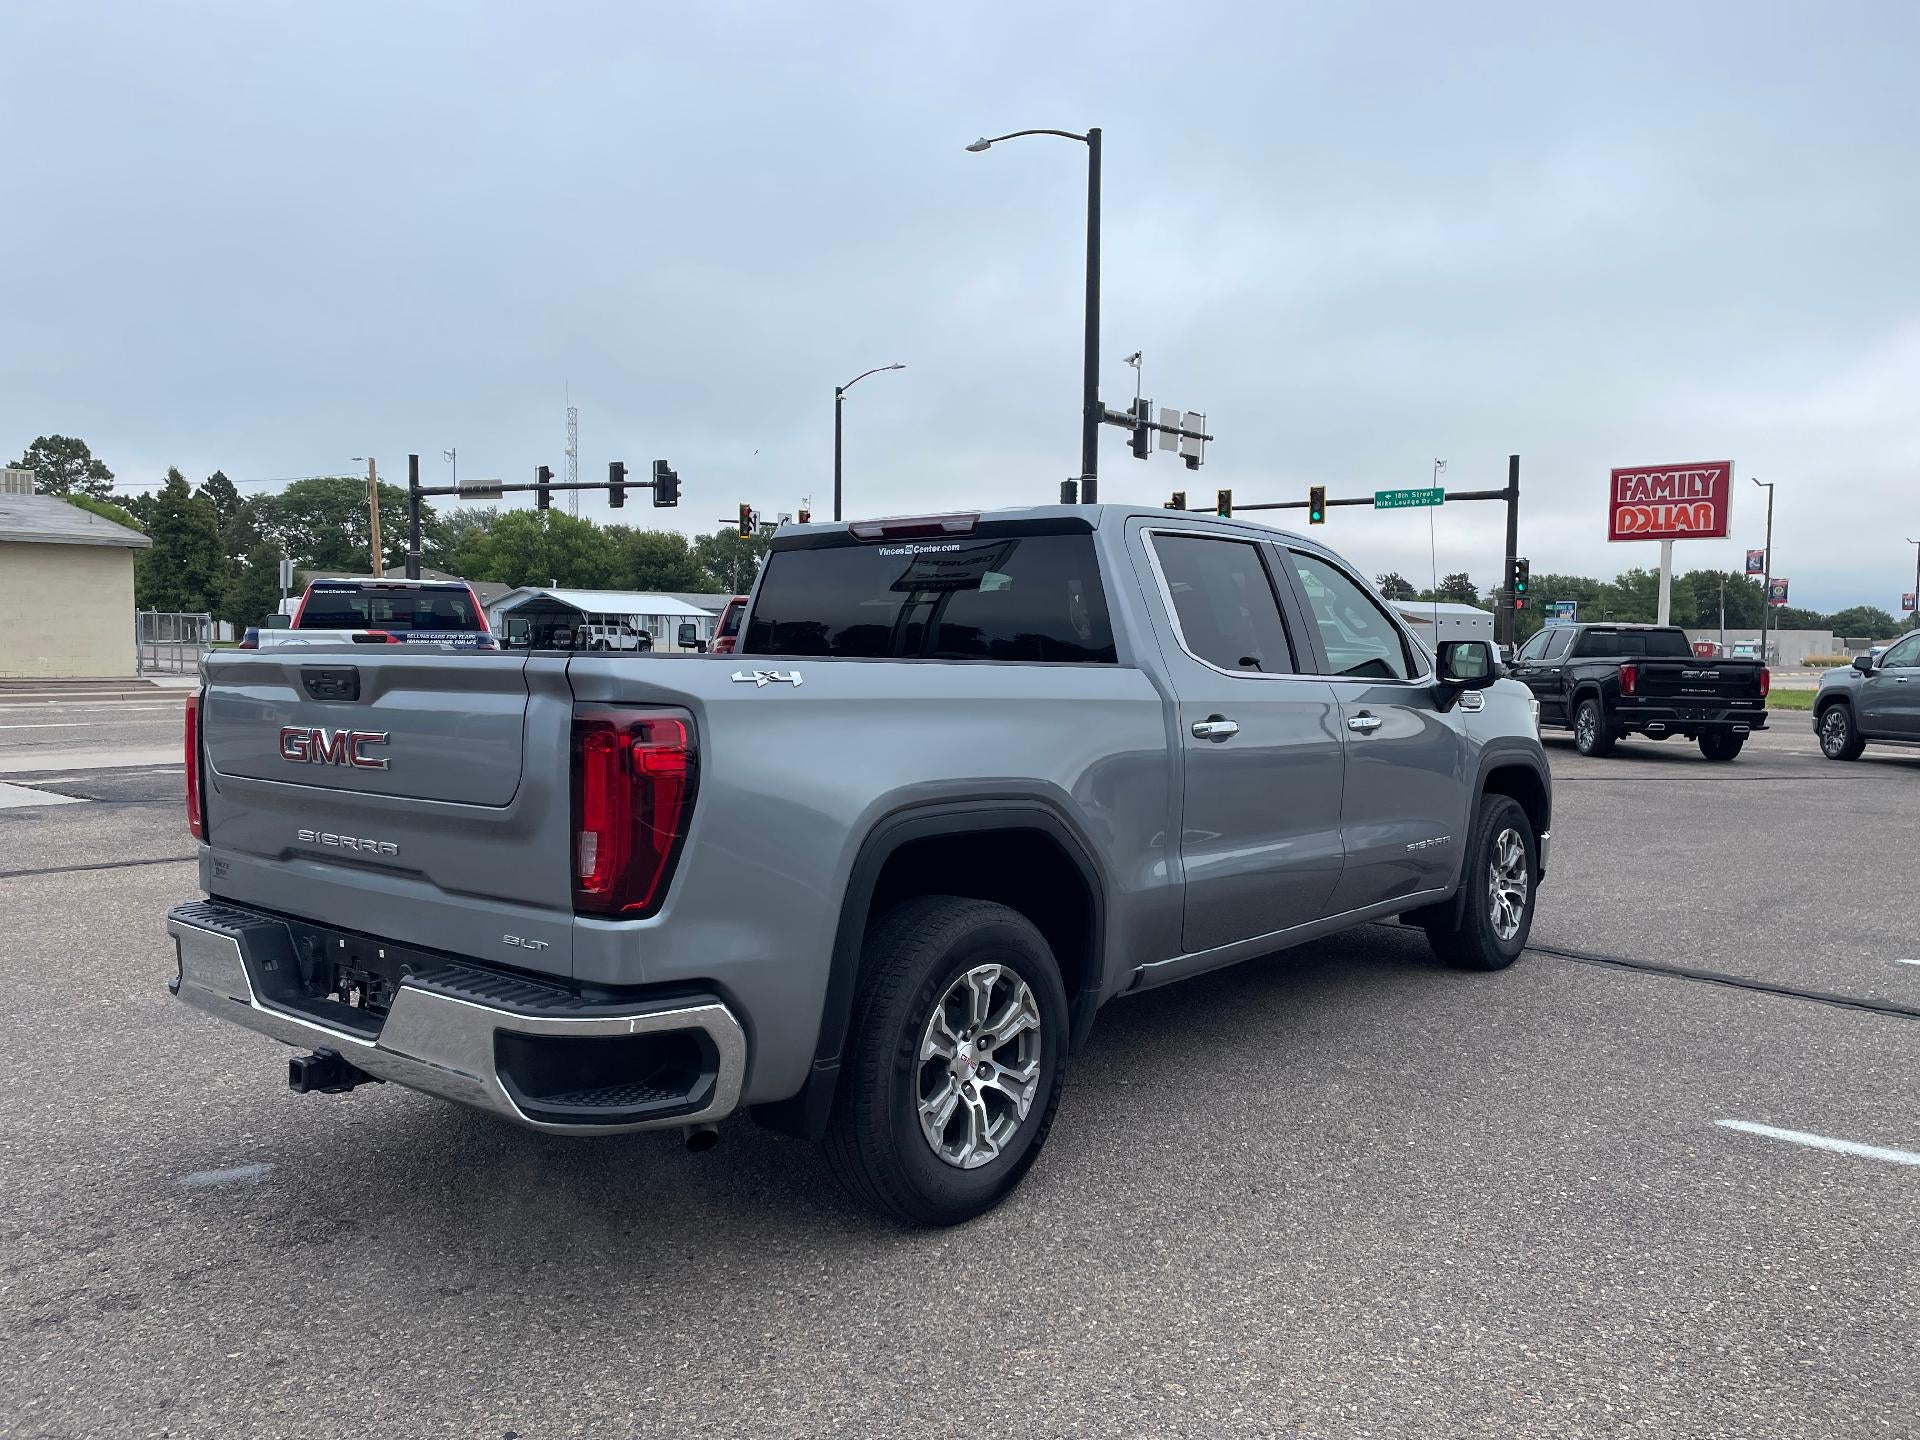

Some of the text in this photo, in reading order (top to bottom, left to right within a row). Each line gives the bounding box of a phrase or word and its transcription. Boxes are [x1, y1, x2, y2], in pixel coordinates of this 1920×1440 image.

[1411, 490, 1434, 498] Street
[1617, 469, 1721, 502] FAMILY
[1616, 502, 1714, 534] DOLLAR
[280, 725, 390, 770] GMC
[298, 829, 399, 856] SIERRA
[1405, 835, 1451, 852] SIERRA
[503, 934, 549, 951] SLT
